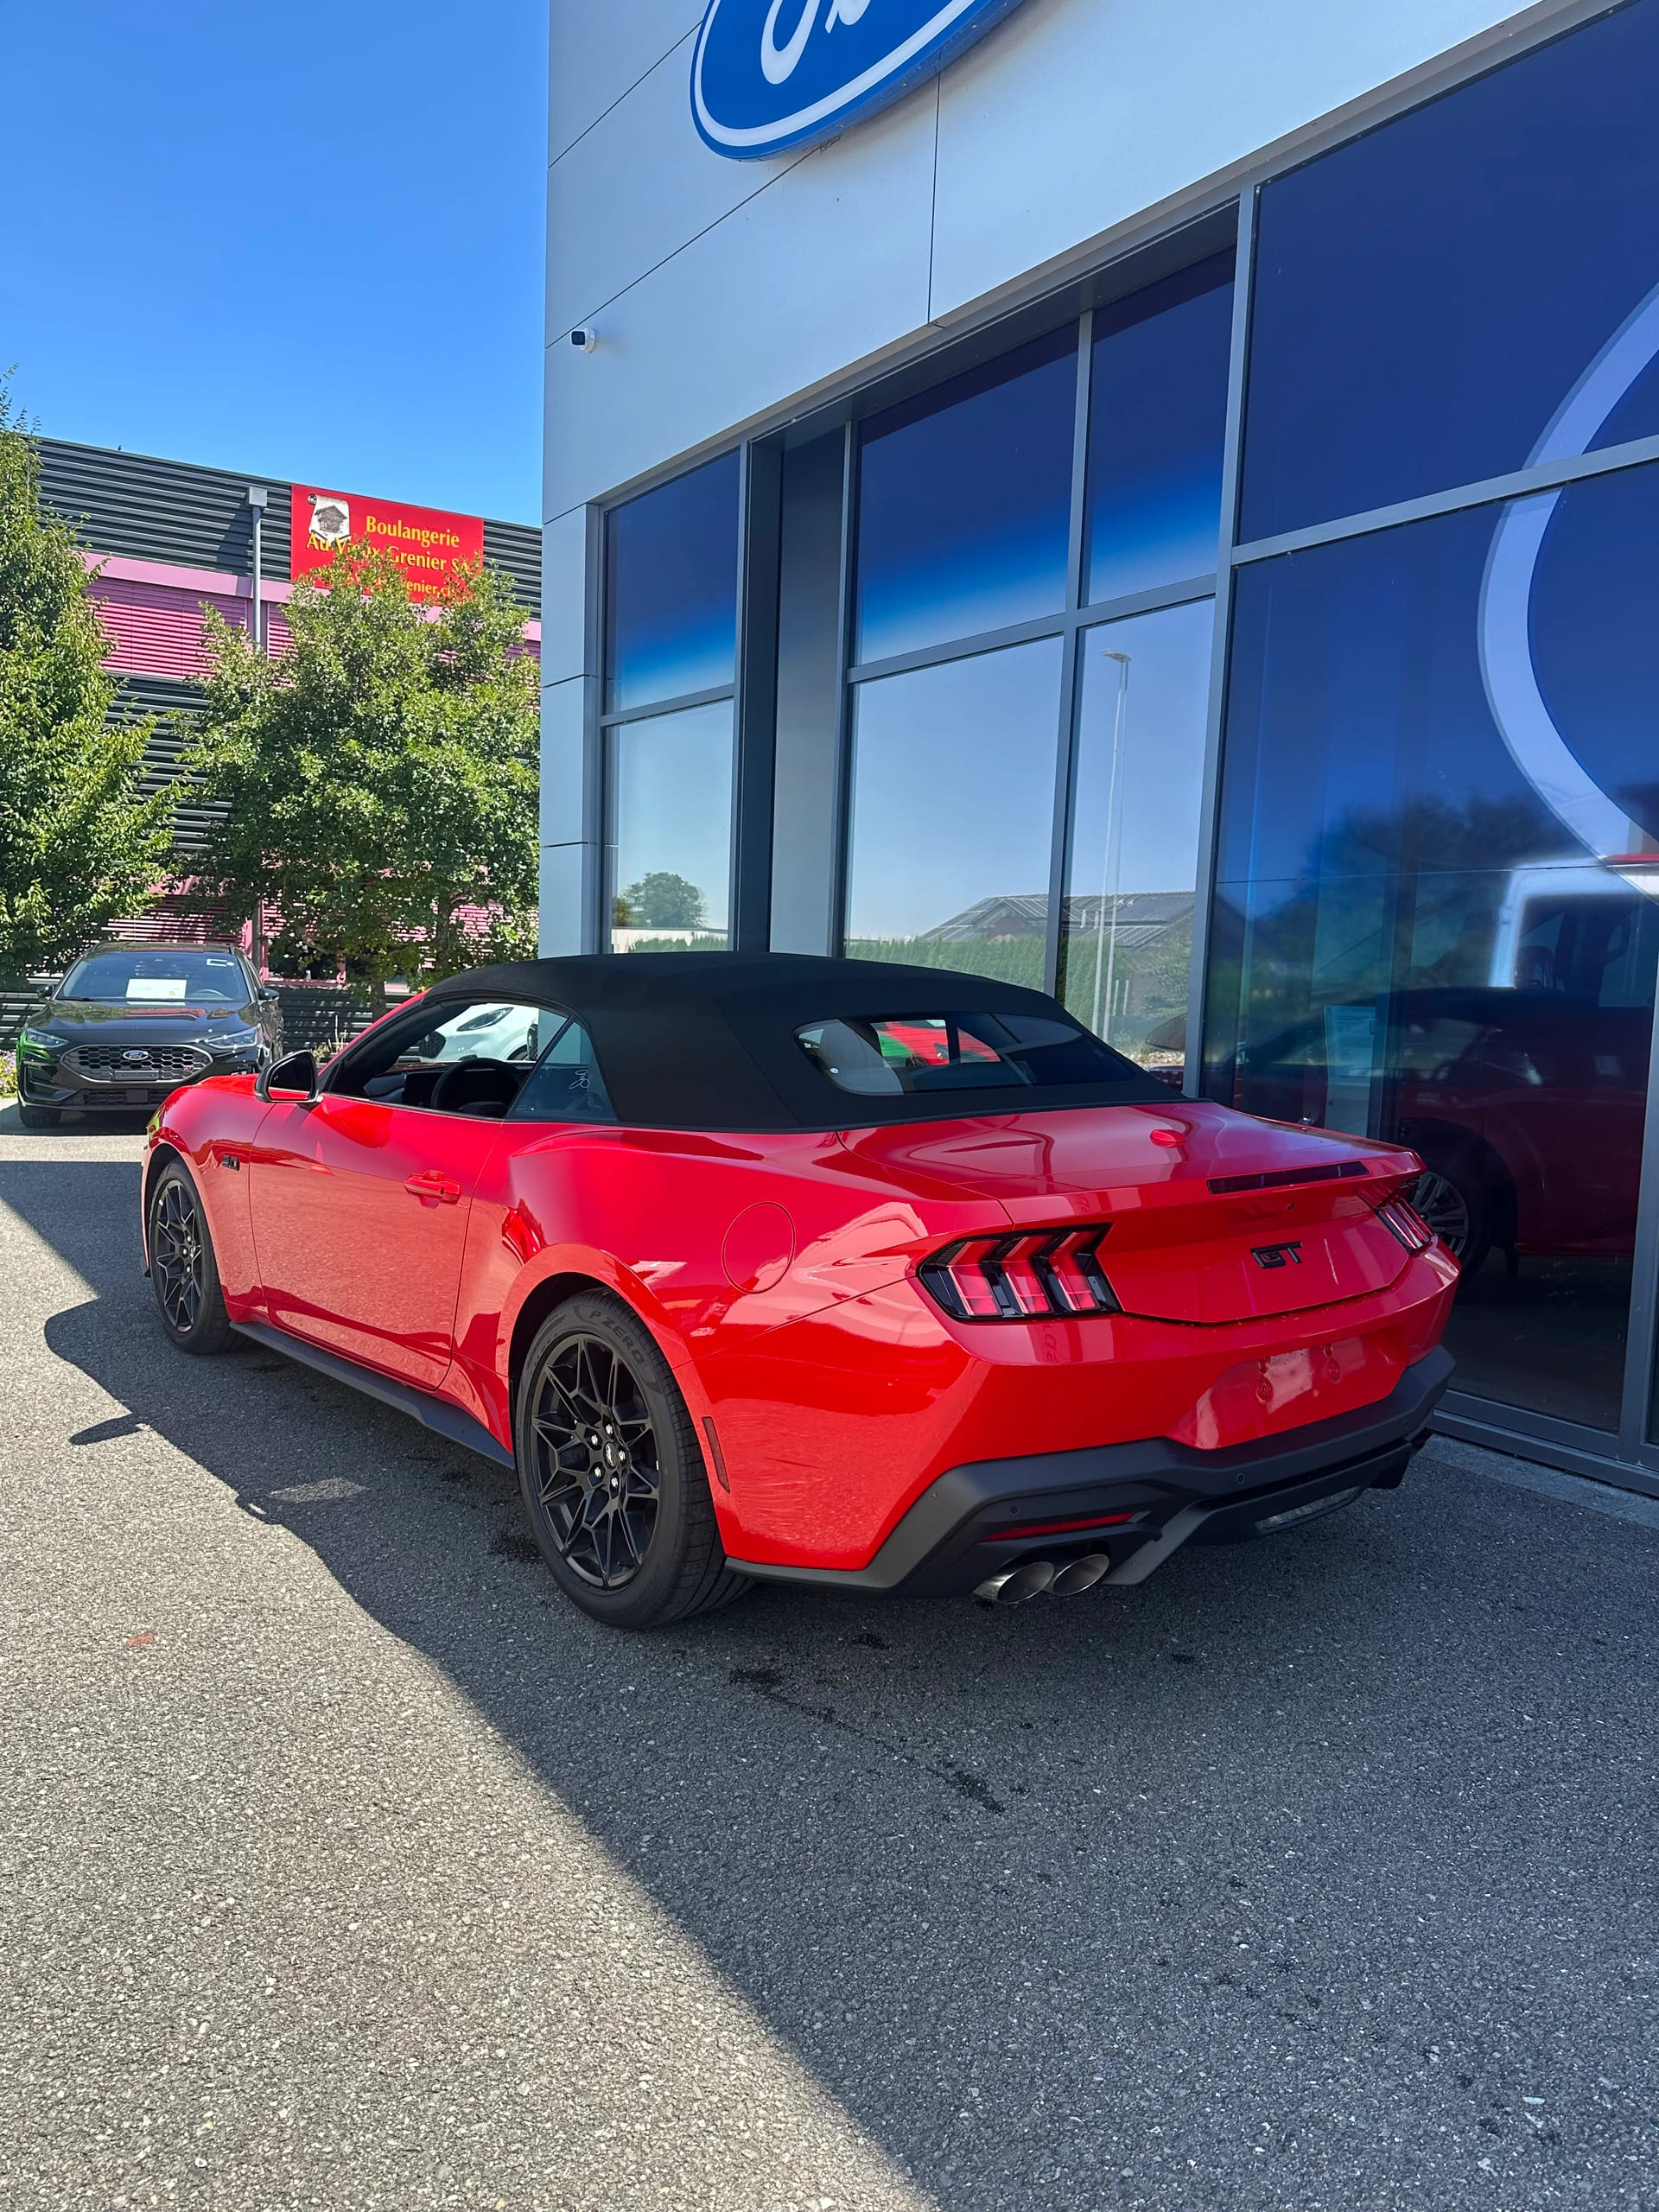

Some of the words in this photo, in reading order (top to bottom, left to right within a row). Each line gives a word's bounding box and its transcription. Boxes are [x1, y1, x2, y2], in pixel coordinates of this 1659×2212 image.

[365, 515, 460, 548] Boulangerie
[306, 532, 329, 552] Au
[387, 545, 447, 571] Grenier
[1249, 1241, 1303, 1269] GT
[601, 1317, 645, 1363] ZERO
